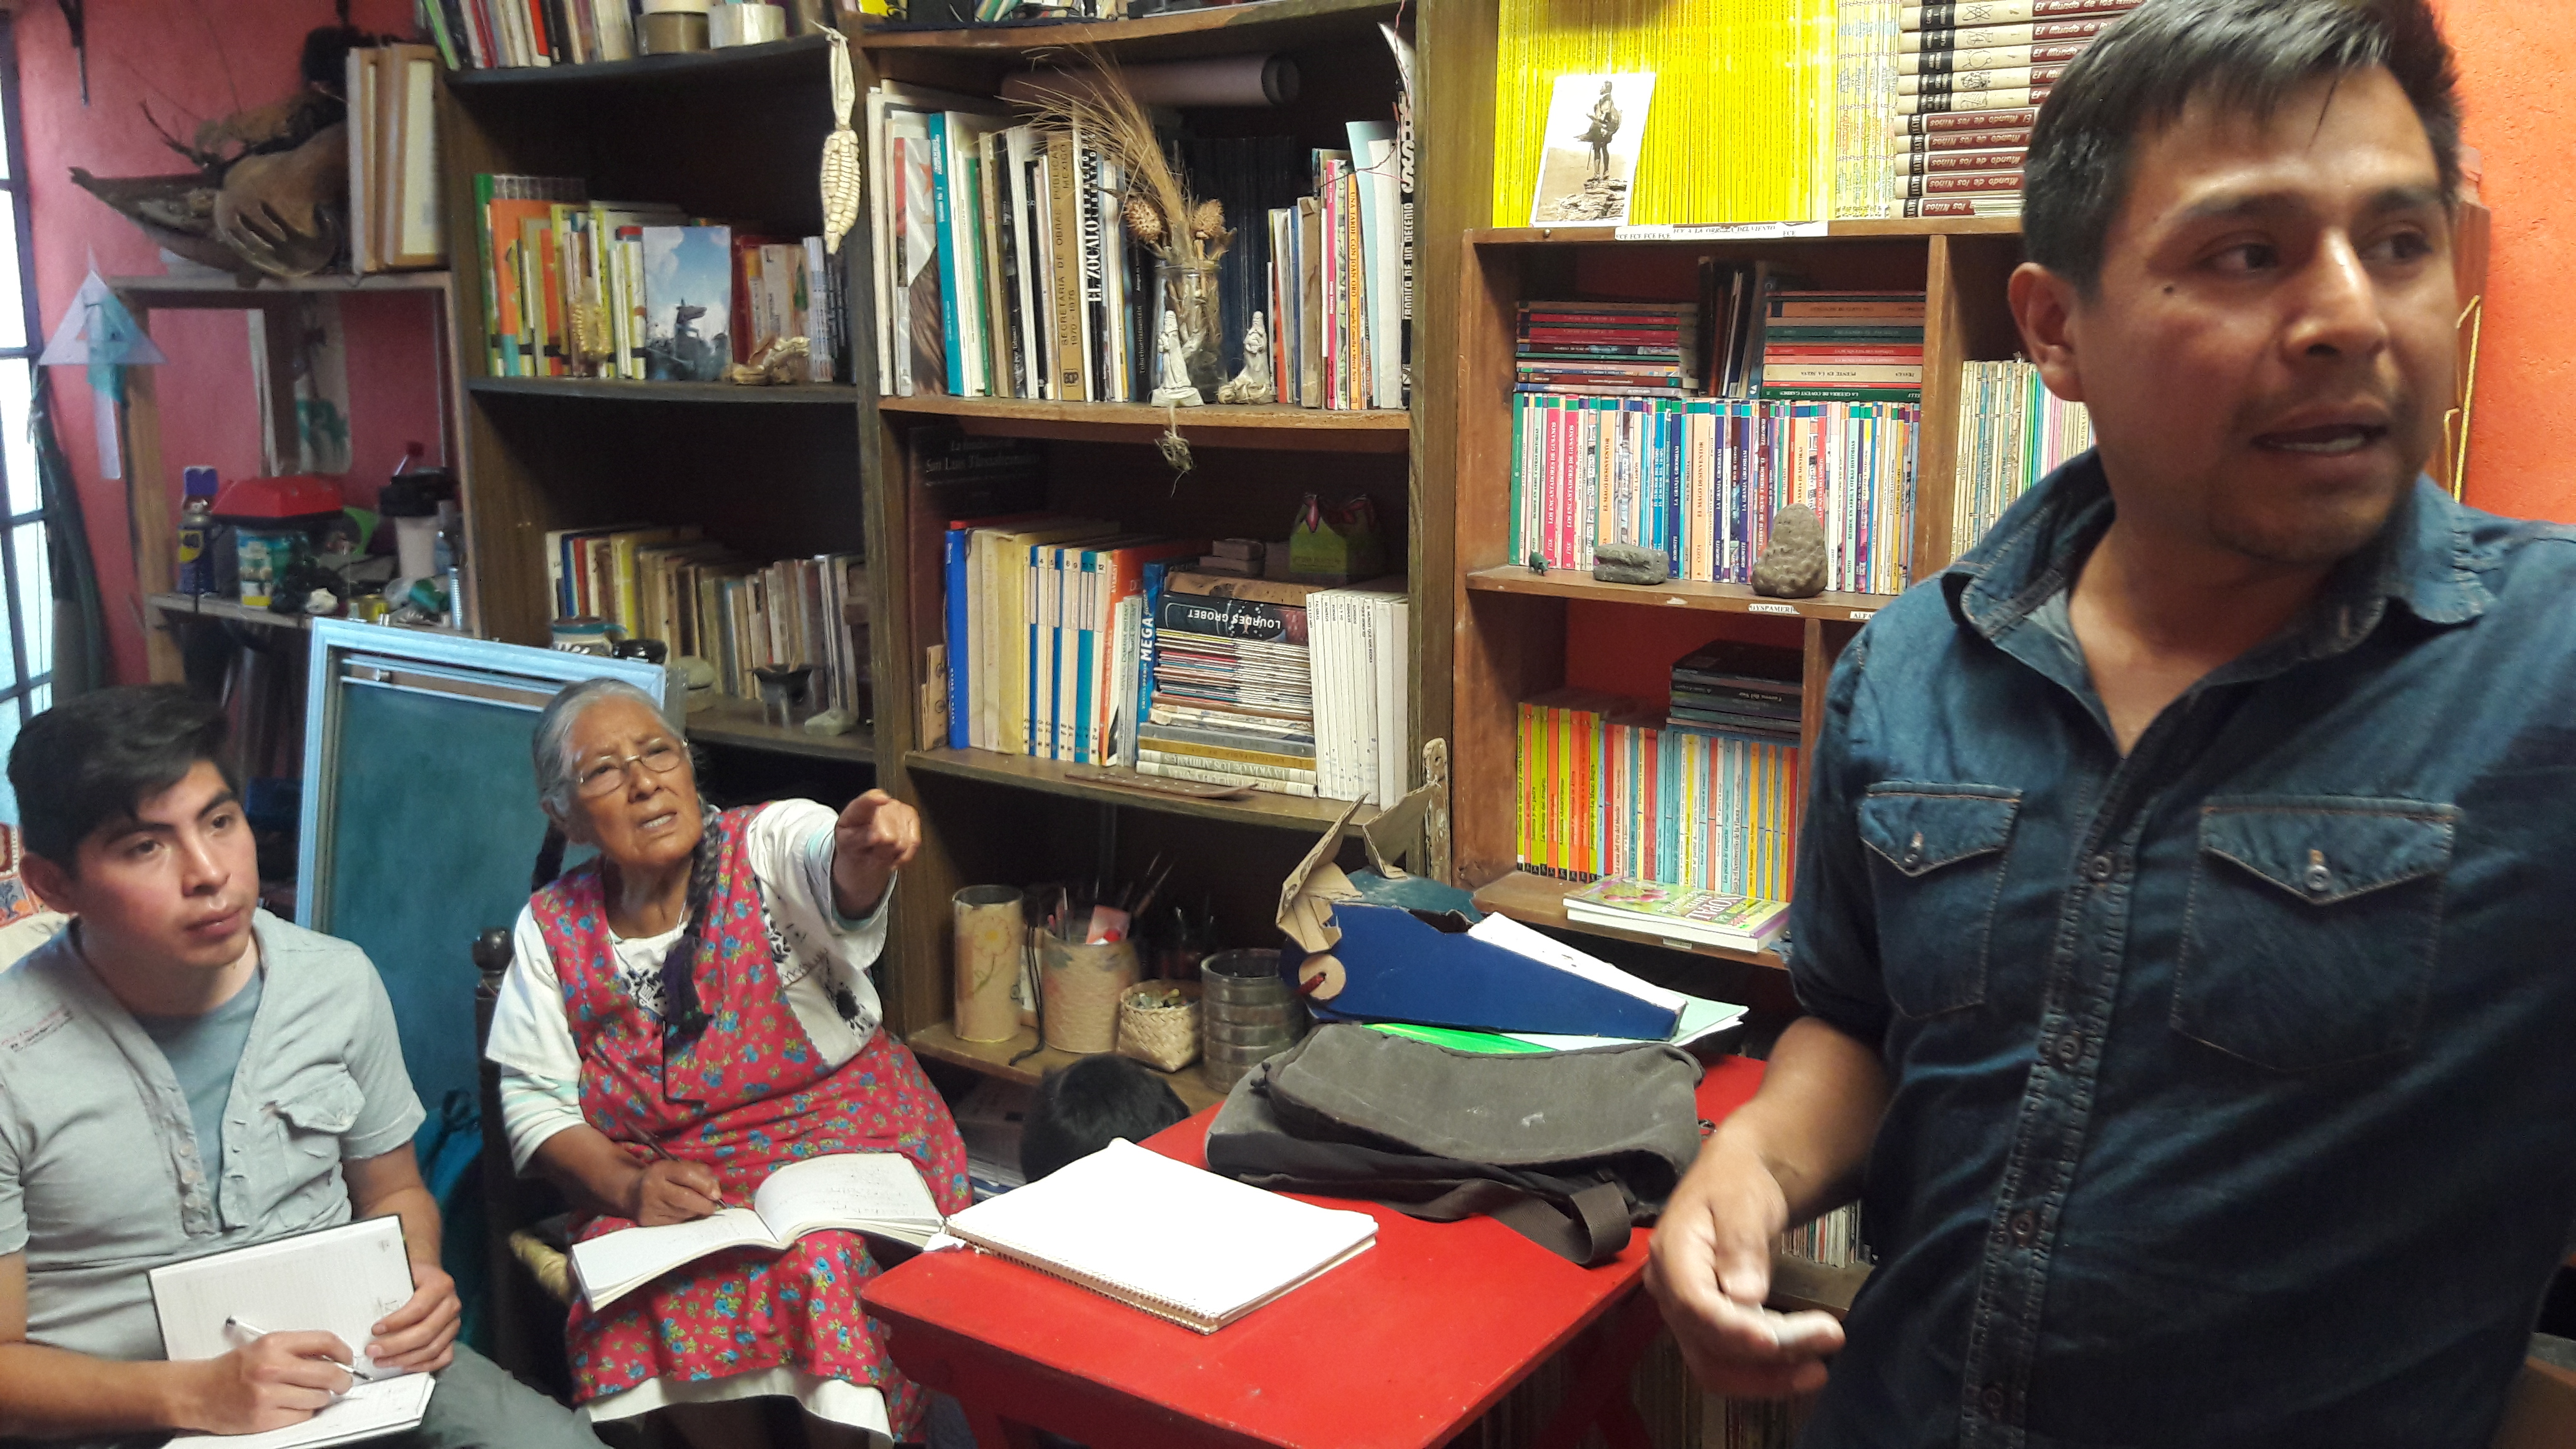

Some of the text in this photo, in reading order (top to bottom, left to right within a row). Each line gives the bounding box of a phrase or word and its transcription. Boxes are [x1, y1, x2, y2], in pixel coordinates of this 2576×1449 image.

[2049, 1, 2080, 10] Mundo
[2036, 23, 2095, 34] El Mundo de
[2034, 46, 2077, 57] El Mundo
[2032, 70, 2041, 79] El
[2031, 90, 2041, 99] El
[1989, 115, 2019, 124] Mundo
[2023, 114, 2032, 122] El
[1930, 119, 1954, 127] Niños
[1932, 137, 1956, 146] Niños
[1991, 134, 2021, 142] Mundo
[1931, 156, 2021, 167] Mundo de los Niños
[1928, 180, 1954, 188] Niños
[1988, 177, 2019, 186] Mundo
[1925, 203, 1951, 212] Niños
[1054, 209, 1064, 246] OBRAS
[1056, 254, 1065, 268] DE
[1085, 220, 1102, 302] EL ZOCALO
[1349, 259, 1357, 278] JOAN
[1058, 276, 1068, 346] SECRETARIA
[1070, 324, 1078, 346] 1970
[1549, 452, 1555, 461] DE
[1568, 456, 1573, 464] DE
[1715, 502, 1721, 510] LA
[1188, 609, 1281, 629] LOURDES GROBET
[1140, 618, 1153, 661] MEGA
